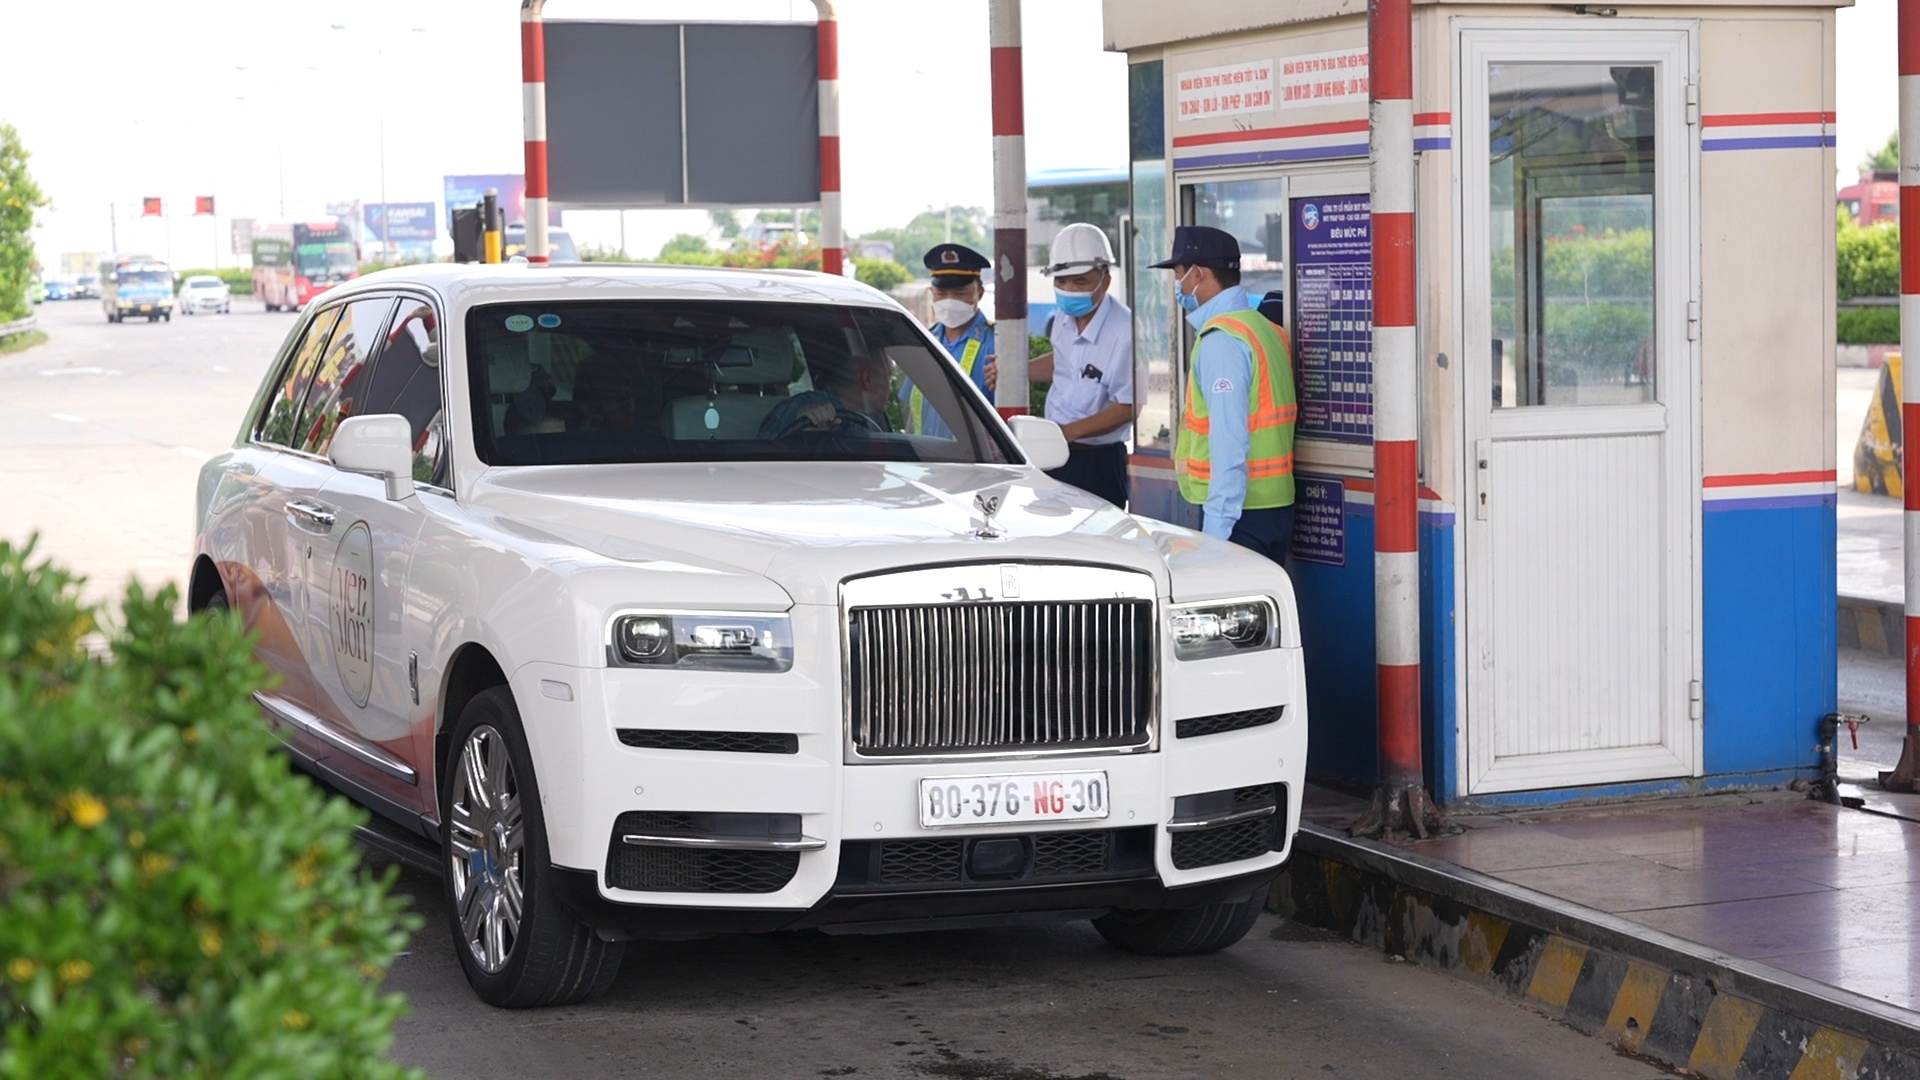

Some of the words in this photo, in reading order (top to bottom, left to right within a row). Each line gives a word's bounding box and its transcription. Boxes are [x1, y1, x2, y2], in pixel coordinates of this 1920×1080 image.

[1357, 226, 1367, 237] PHÍ
[1306, 485, 1320, 498] CHÚ
[929, 778, 1102, 819] 80-376-NG-30
